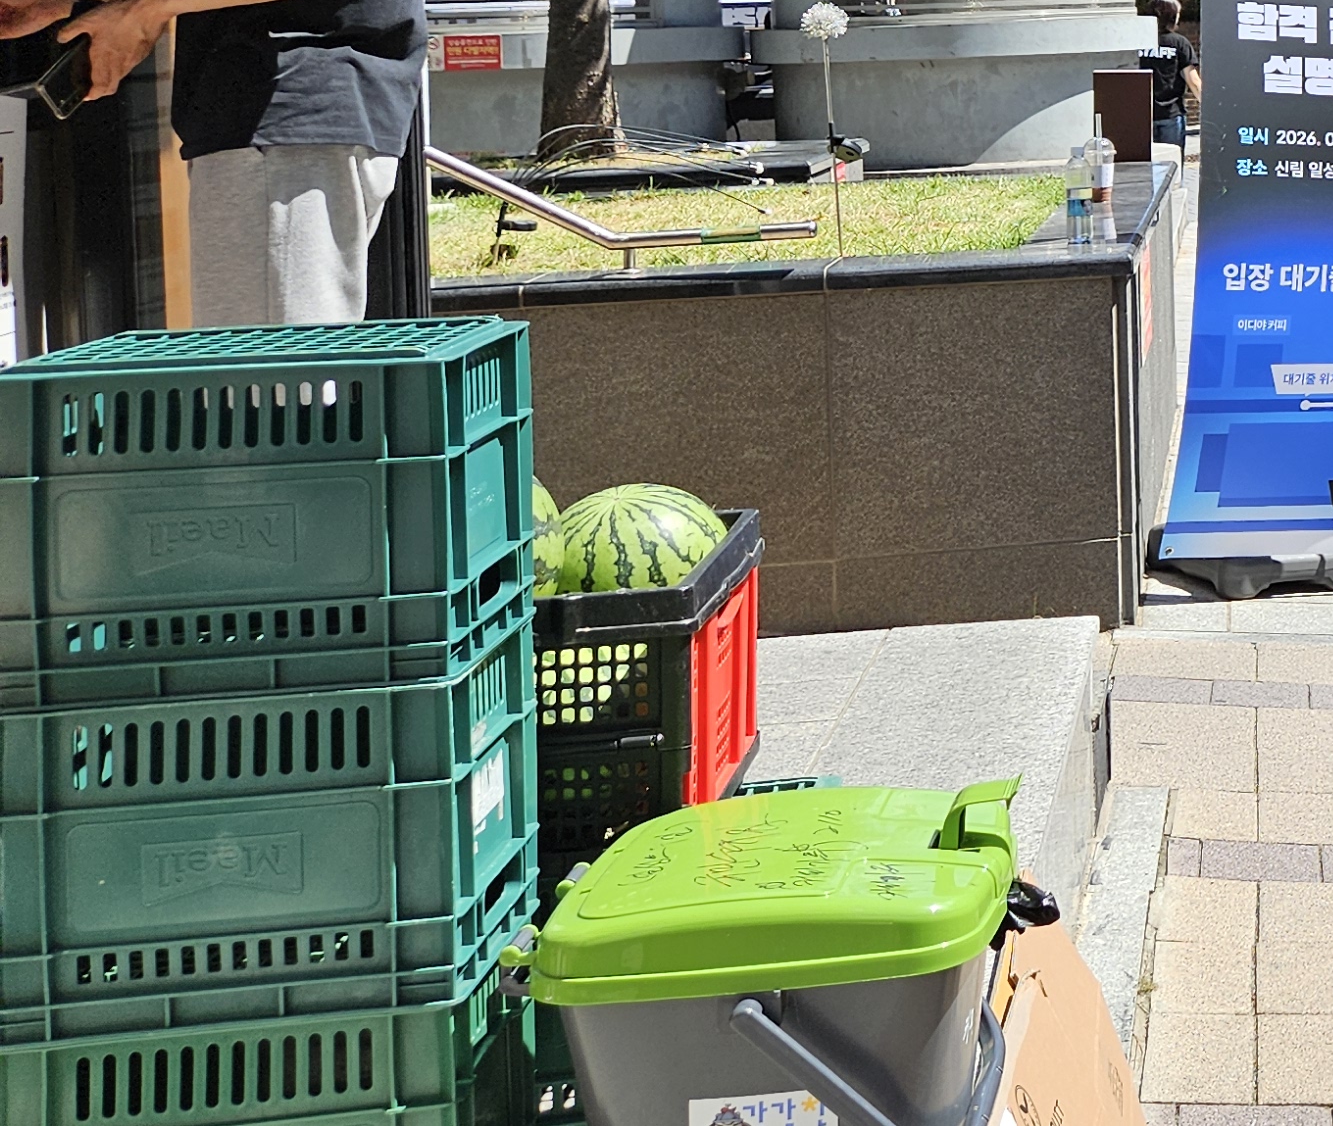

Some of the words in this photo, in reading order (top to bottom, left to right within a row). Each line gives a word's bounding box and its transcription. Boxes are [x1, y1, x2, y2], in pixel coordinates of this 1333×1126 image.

[1237, 2, 1318, 44] 합격
[1238, 127, 1269, 146] 일시
[1276, 130, 1321, 147] 2026.
[1236, 159, 1268, 176] 장소
[1274, 160, 1304, 178] 신림
[1223, 263, 1273, 291] 입장
[1237, 319, 1266, 332] 이디야
[1267, 319, 1287, 332] 커피
[1282, 372, 1317, 386] 대기줄
[146, 512, 280, 557] Maeil
[154, 844, 288, 888] Maeil
